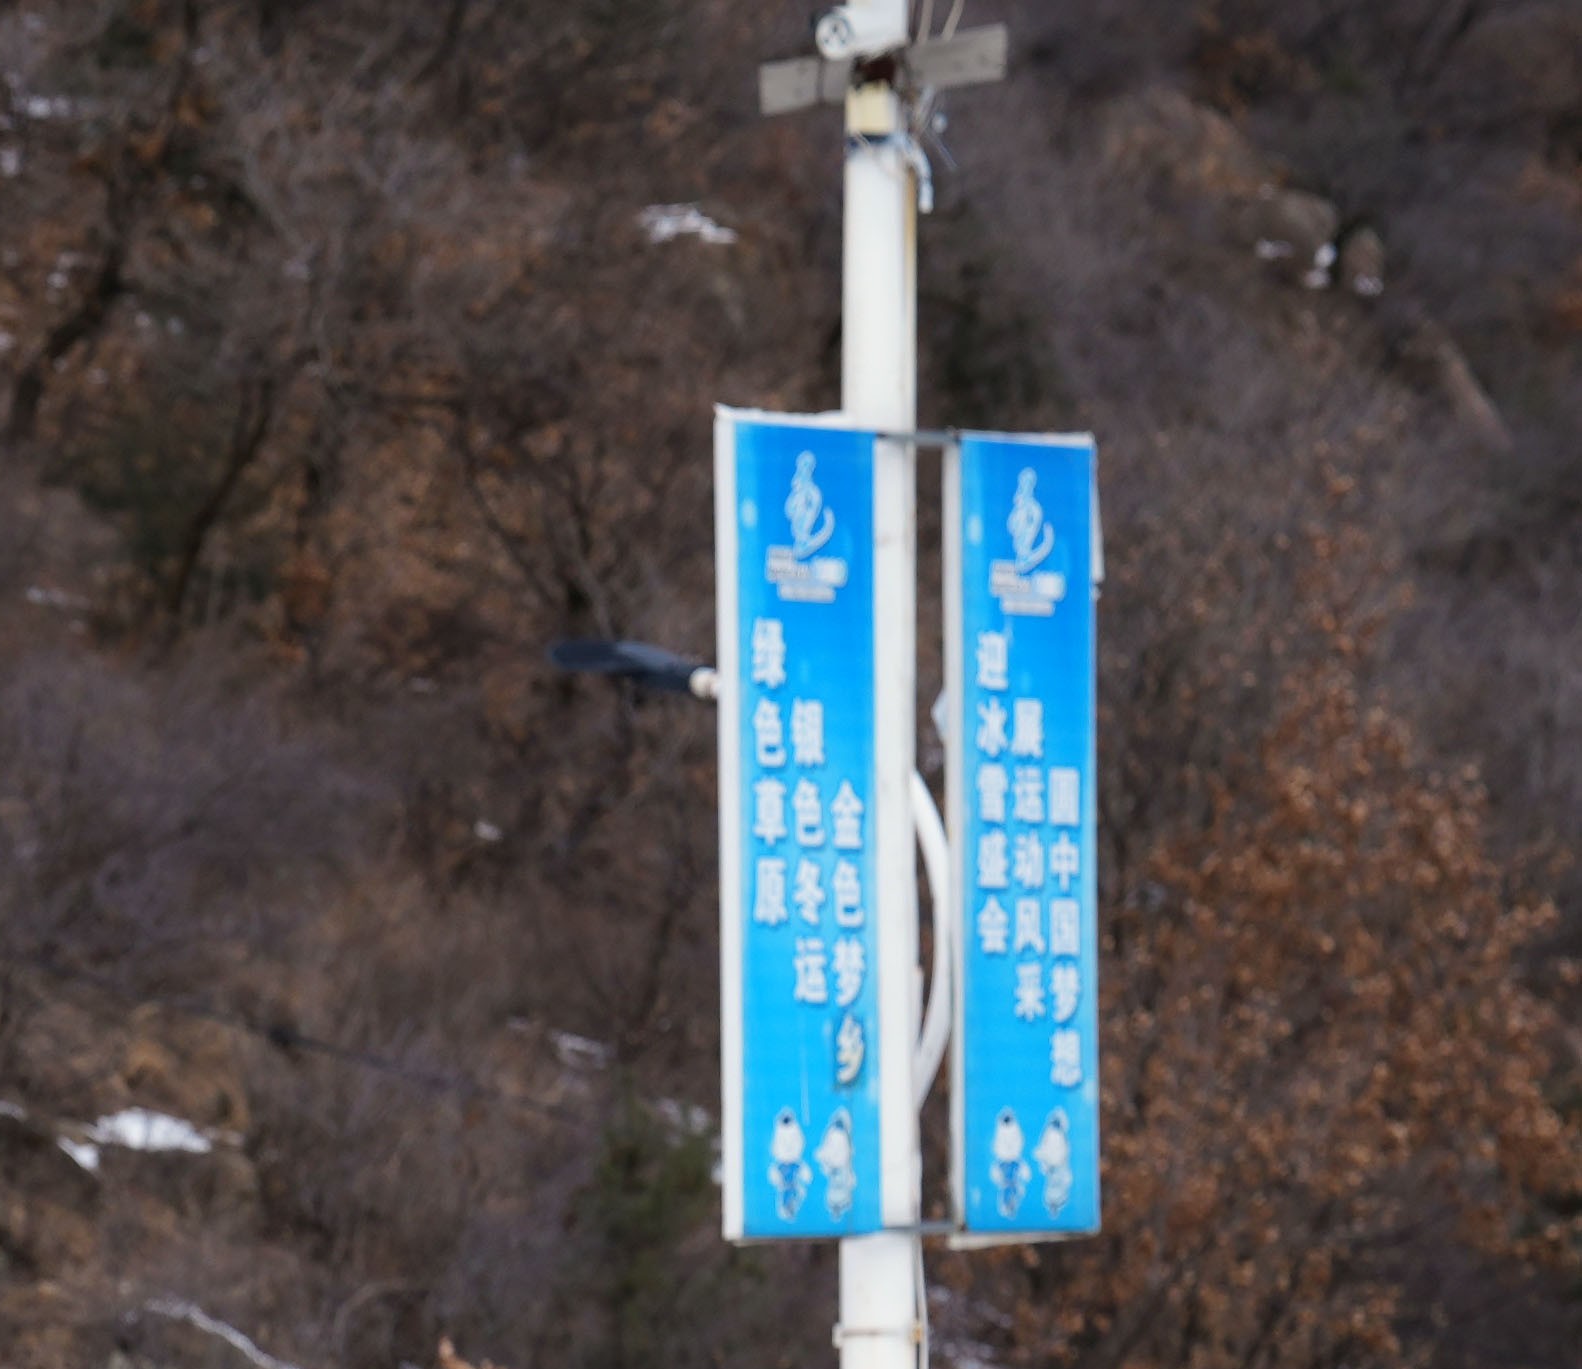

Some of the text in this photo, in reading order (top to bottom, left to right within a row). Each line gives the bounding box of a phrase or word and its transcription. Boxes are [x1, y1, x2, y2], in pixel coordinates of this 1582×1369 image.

[752, 617, 787, 927] 绿色草原
[791, 698, 827, 1003] 银色冬运
[976, 630, 1008, 954] 迎冰雪盛会
[1011, 698, 1046, 1021] 展运动风采
